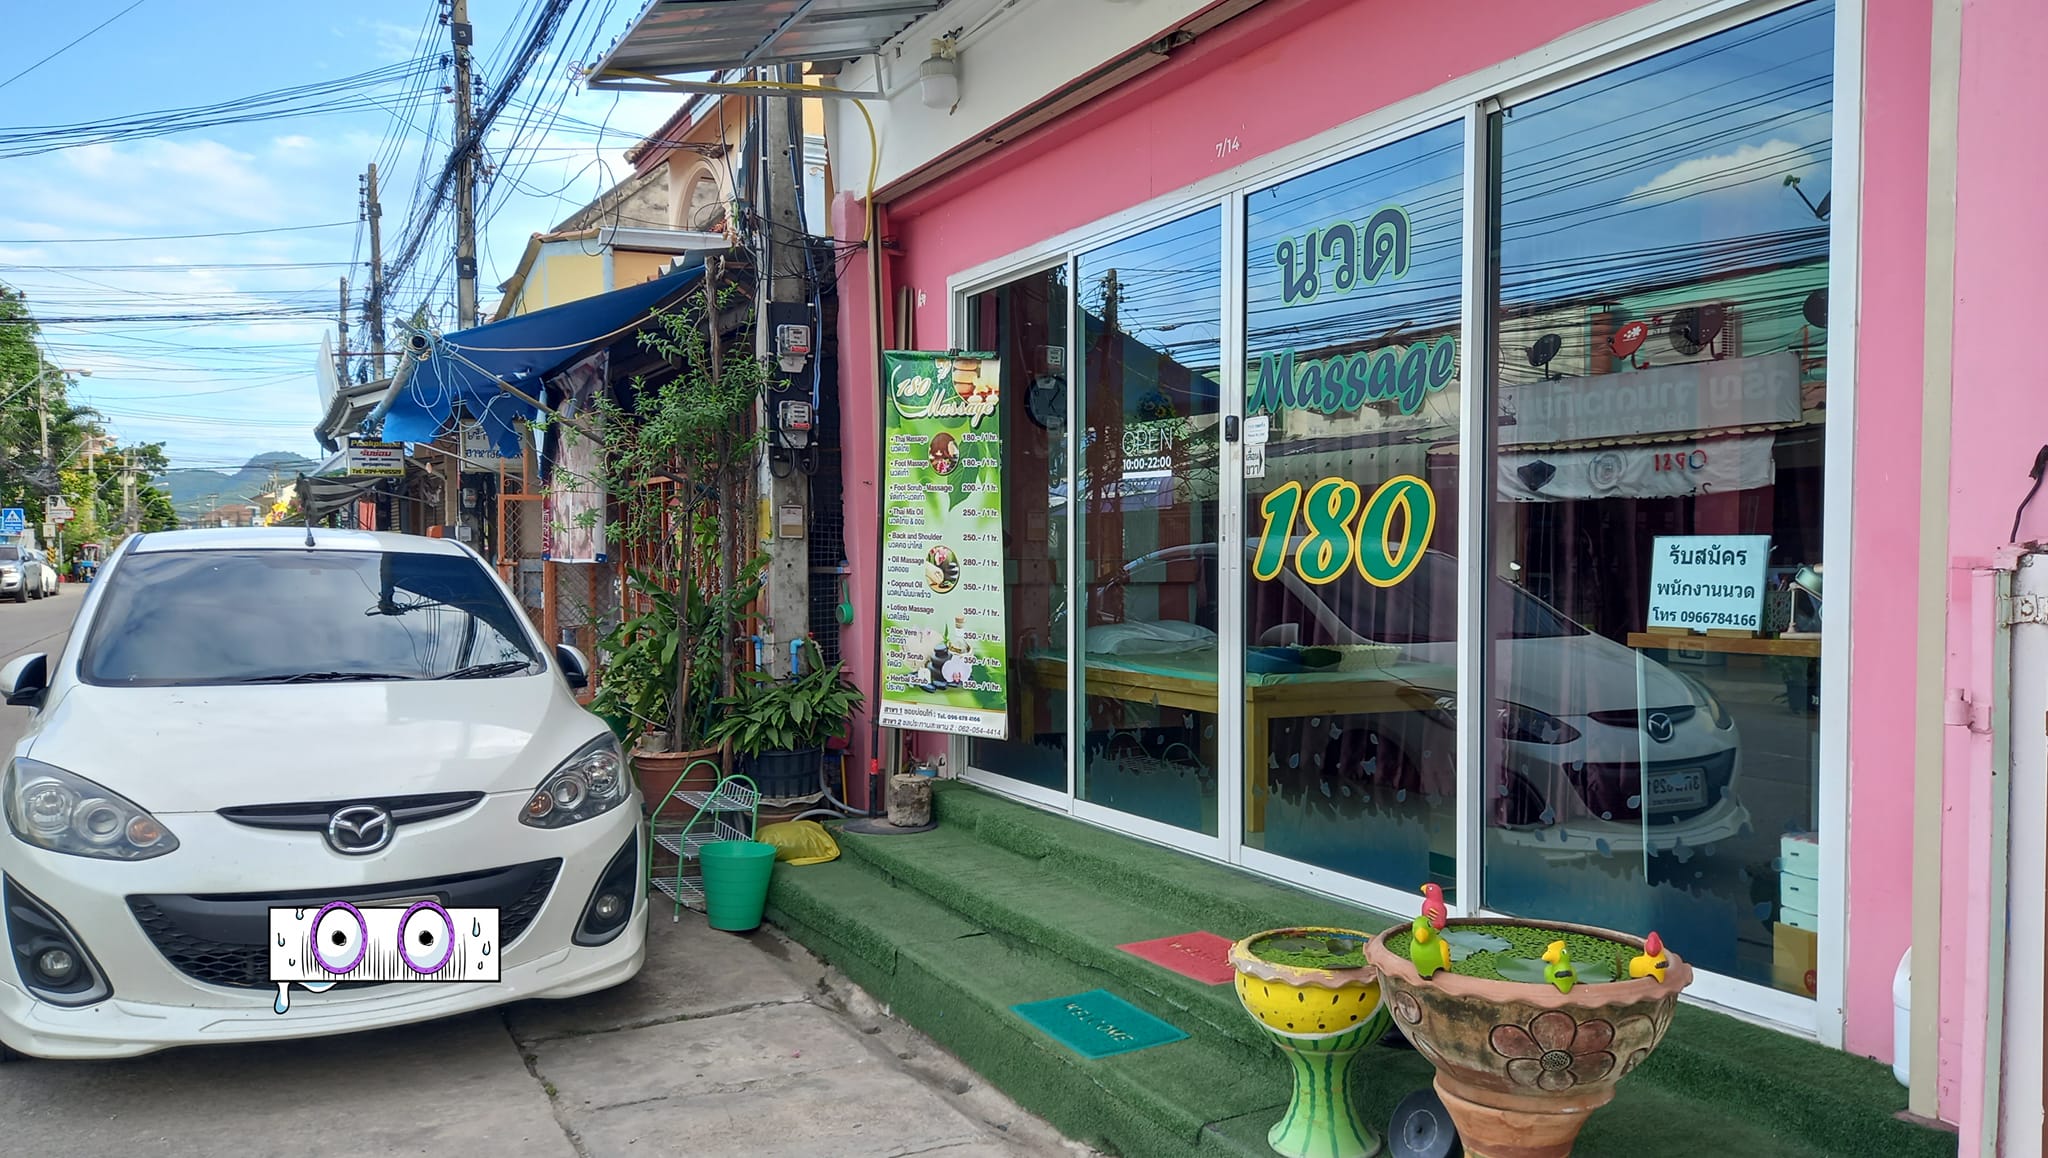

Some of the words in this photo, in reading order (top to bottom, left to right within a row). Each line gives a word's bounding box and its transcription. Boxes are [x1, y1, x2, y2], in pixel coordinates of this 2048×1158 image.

[1215, 136, 1240, 158] 7/14
[1276, 204, 1411, 307] นวด
[1247, 335, 1456, 416] Massage
[896, 376, 932, 397] 180
[926, 388, 994, 428] Massage
[905, 436, 927, 444] Massage
[1122, 427, 1173, 456] OPEN
[907, 460, 928, 468] Massage
[1122, 456, 1172, 470] 10:00-22:00
[926, 484, 953, 493] Massage
[963, 484, 981, 492] 200.-
[1253, 475, 1436, 587] 180
[907, 532, 917, 540] and
[918, 533, 942, 541] Shoulder
[1669, 545, 1748, 566] รับสมัคร
[900, 556, 924, 566] Massage
[891, 580, 914, 588] Coconut
[963, 583, 981, 591] 350.-
[1657, 579, 1755, 599] พนักงานนวด
[908, 605, 934, 615] Massage
[963, 607, 981, 615] 350.-
[1652, 606, 1677, 622] โทร
[1680, 610, 1757, 627] 0966784166
[904, 628, 917, 637] Vera
[963, 632, 981, 640] 350.-
[890, 651, 906, 660] Body
[907, 652, 924, 660] Scrub
[910, 676, 928, 684] Scrub
[963, 681, 981, 689] 350.-
[958, 725, 1001, 736] 062-054-4414
